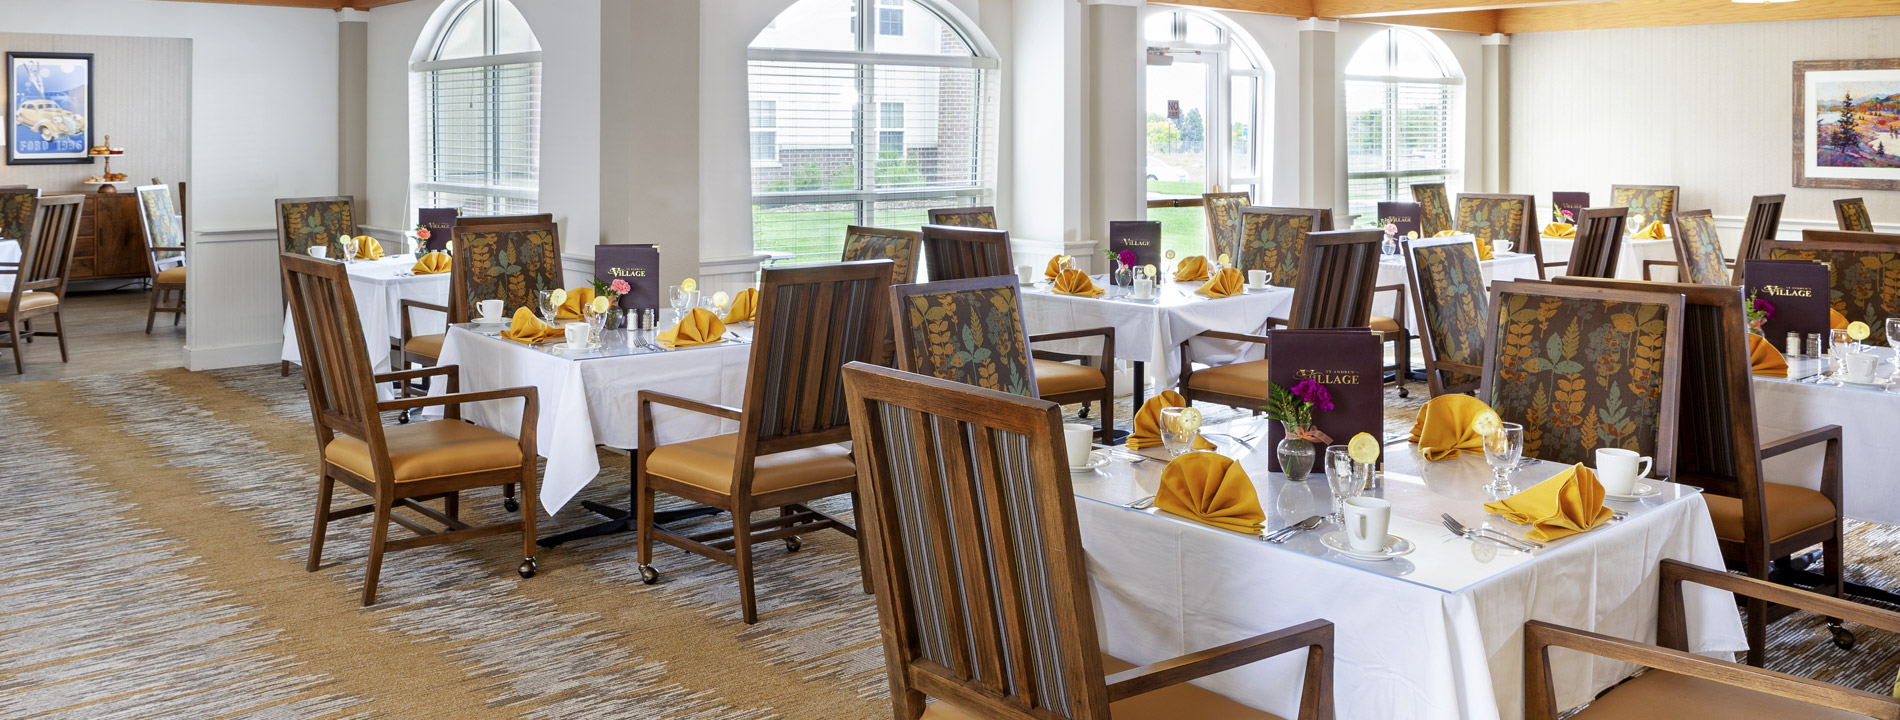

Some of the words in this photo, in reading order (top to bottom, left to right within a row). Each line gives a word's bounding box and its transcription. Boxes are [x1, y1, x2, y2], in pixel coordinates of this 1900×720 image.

[1168, 101, 1178, 110] NO
[20, 140, 49, 152] FORD
[56, 140, 83, 152] 1936
[1121, 238, 1151, 246] VILLAGE
[608, 268, 646, 278] VILLAGE
[1761, 284, 1812, 298] VILLAGE
